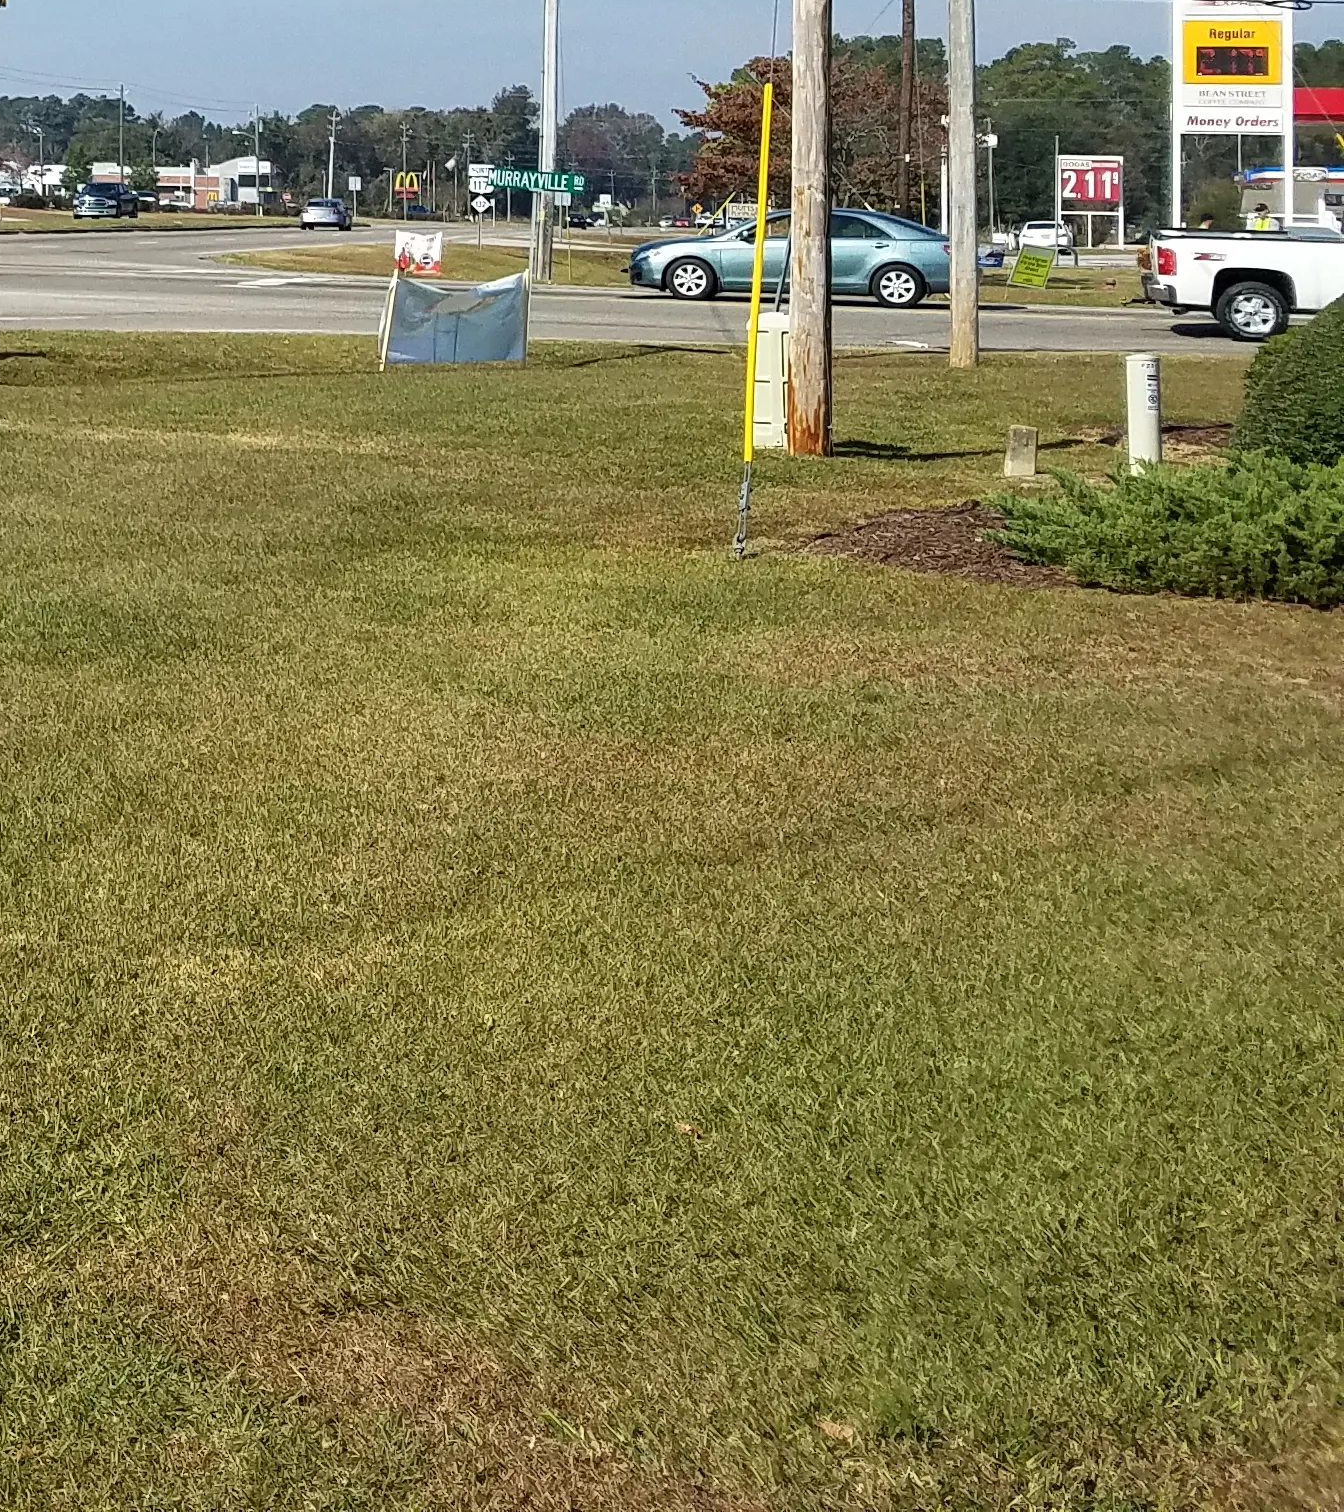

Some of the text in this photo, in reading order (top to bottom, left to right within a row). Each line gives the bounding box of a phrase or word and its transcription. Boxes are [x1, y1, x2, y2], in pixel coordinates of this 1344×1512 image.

[1209, 28, 1255, 41] Regular
[1187, 116, 1279, 128] Money Orders
[474, 180, 489, 190] 117
[488, 169, 585, 190] MURRAYVILLE RD
